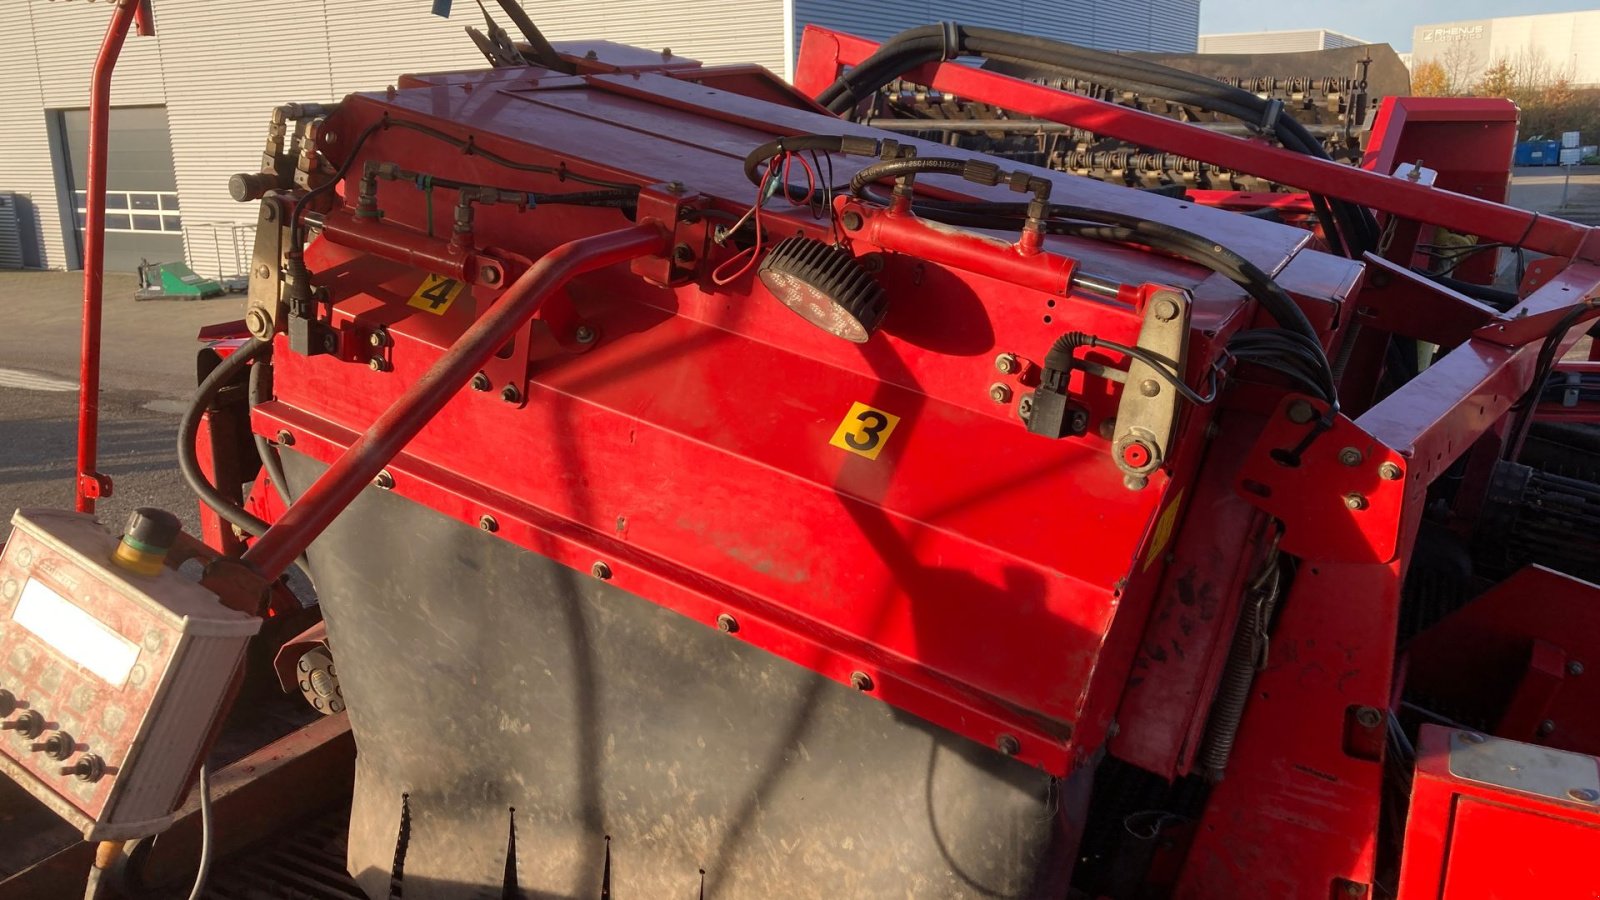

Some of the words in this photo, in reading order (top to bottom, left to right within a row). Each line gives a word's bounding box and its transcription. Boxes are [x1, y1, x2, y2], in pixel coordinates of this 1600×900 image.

[1435, 25, 1484, 35] RHENUS
[420, 278, 458, 309] 4
[845, 410, 888, 451] 3
